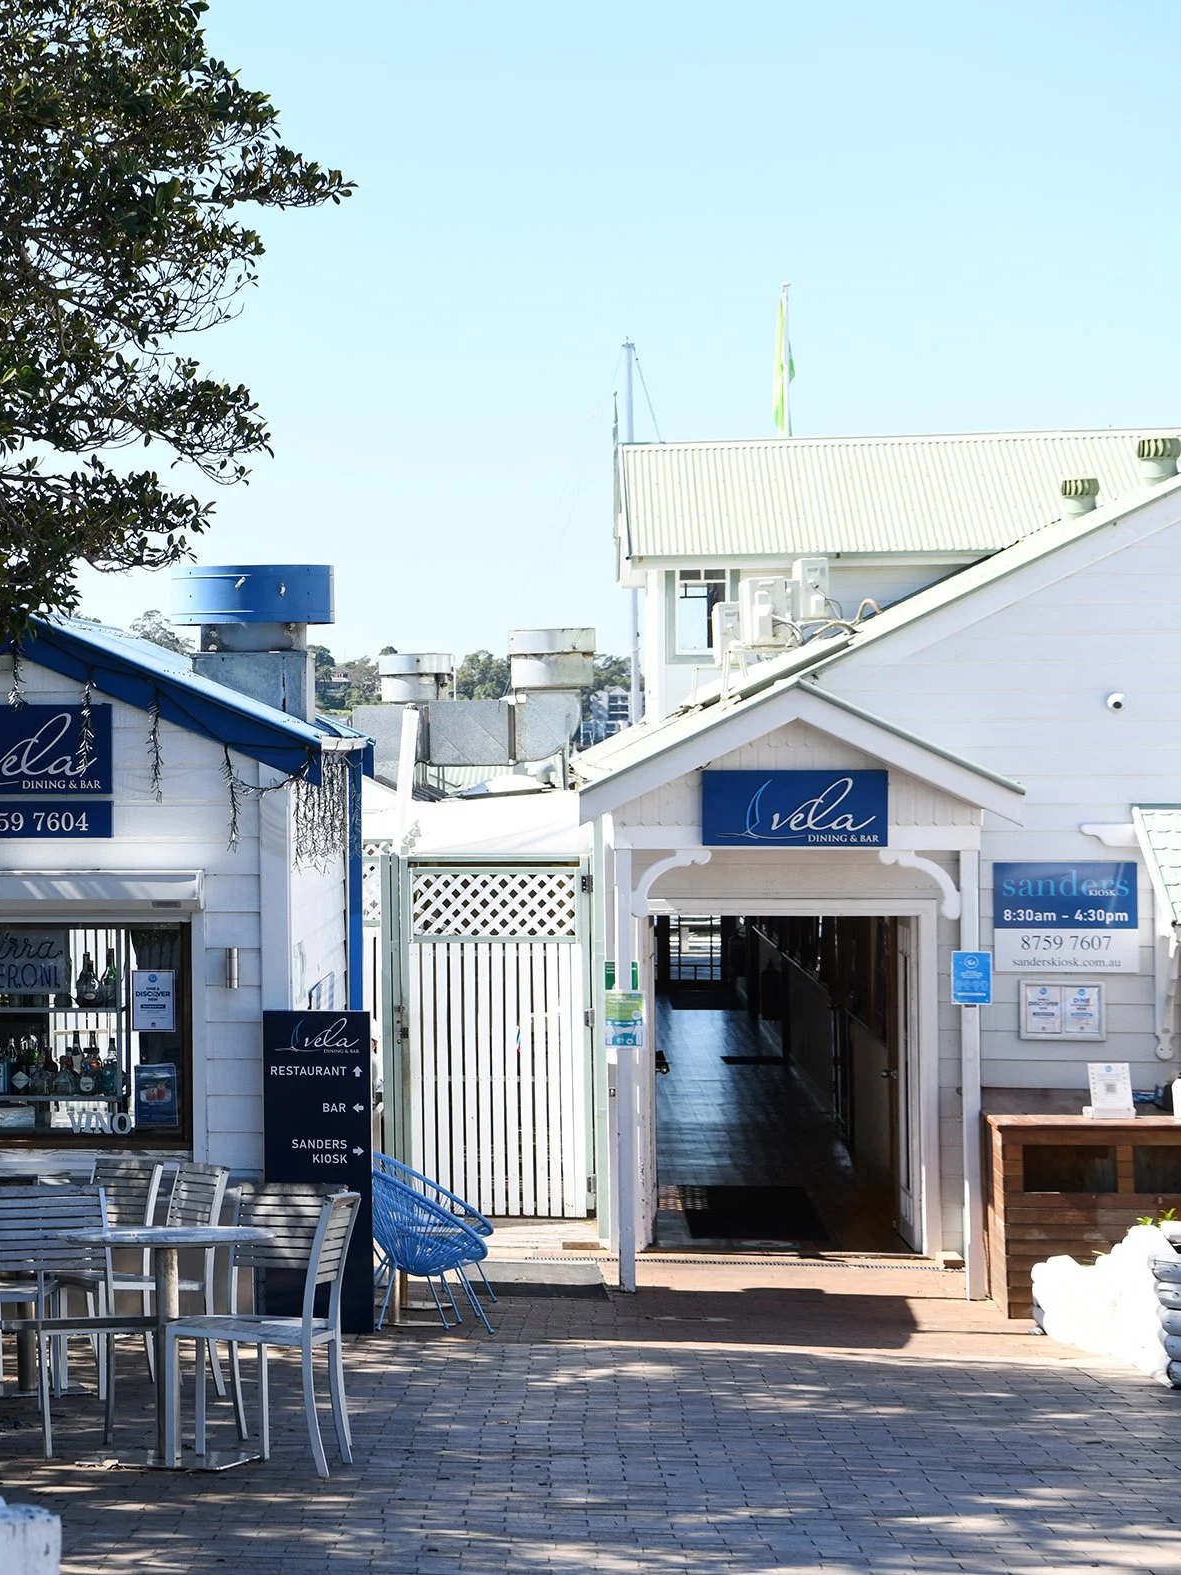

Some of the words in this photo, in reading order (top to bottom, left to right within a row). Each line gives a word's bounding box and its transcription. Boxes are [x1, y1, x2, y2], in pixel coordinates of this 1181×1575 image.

[22, 780, 66, 790] DINING
[68, 780, 78, 790] &
[80, 780, 101, 790] BAR
[771, 777, 877, 832] vela
[33, 812, 89, 832] 7604
[808, 834, 848, 843] DINING
[849, 834, 858, 843] &
[860, 834, 880, 843] BAR
[1002, 869, 1130, 897] sanders
[1088, 889, 1117, 897] KIOSK
[1003, 909, 1057, 922] 8:30am
[1074, 909, 1128, 925] 4:30pm
[1021, 934, 1063, 951] 8759
[1070, 935, 1112, 951] 7607
[1012, 957, 1121, 968] sanderskiosk.com.au
[304, 1017, 360, 1049] vela
[270, 1065, 347, 1076] RESTAURANT
[322, 1102, 347, 1113] BAR
[67, 1111, 131, 1135] VINO
[291, 1139, 348, 1149] SANDERS
[312, 1154, 348, 1164] KIOSK
